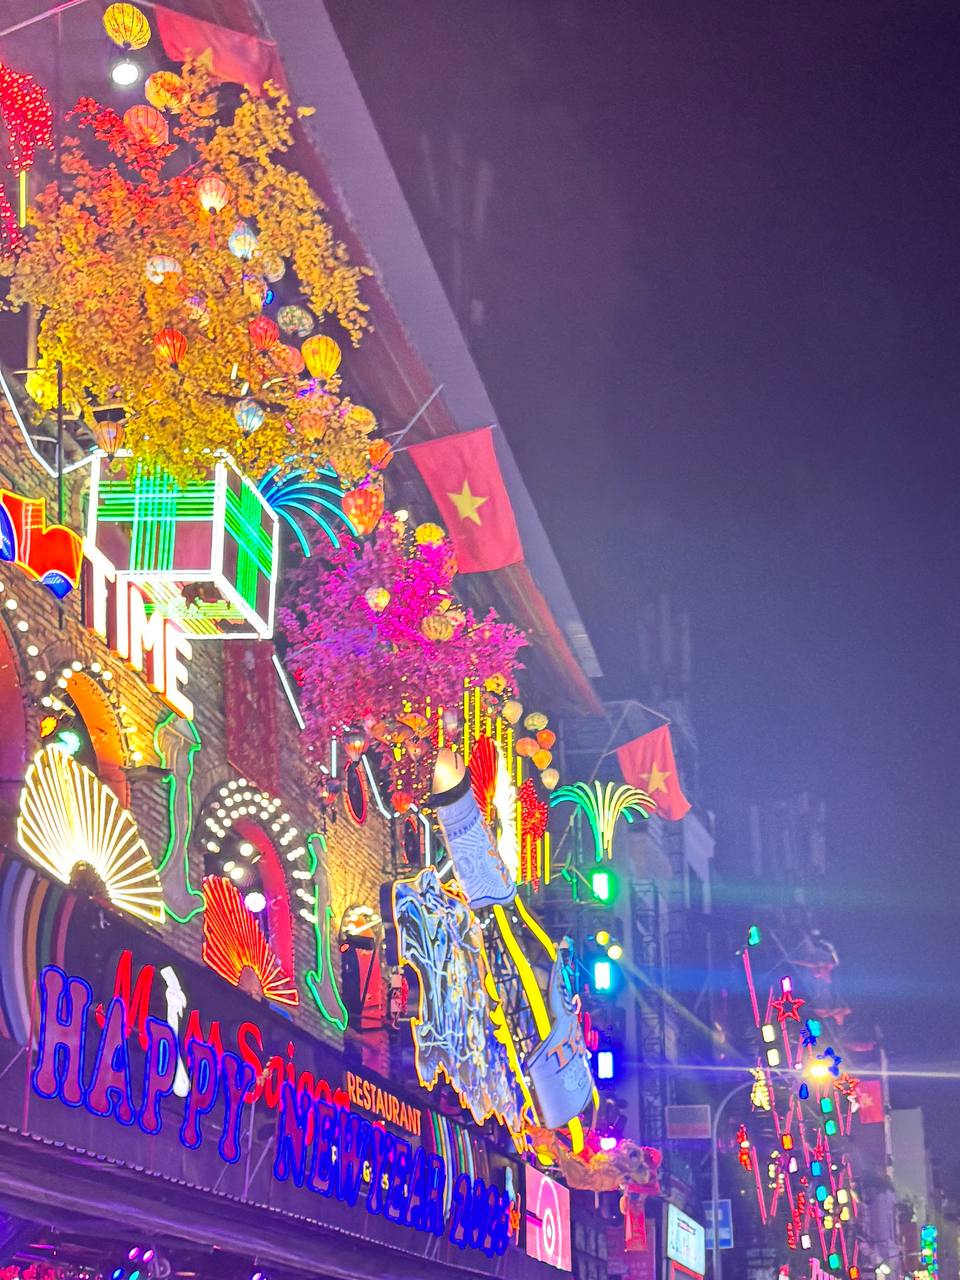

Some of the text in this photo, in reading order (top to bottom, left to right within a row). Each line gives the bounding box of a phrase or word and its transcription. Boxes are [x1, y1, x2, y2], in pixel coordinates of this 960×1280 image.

[83, 540, 194, 721] TIME
[33, 963, 257, 1164] HAPPY
[347, 1071, 422, 1137] RESTAURANT
[273, 1079, 366, 1208] NEW
[362, 1120, 446, 1238] YEAR
